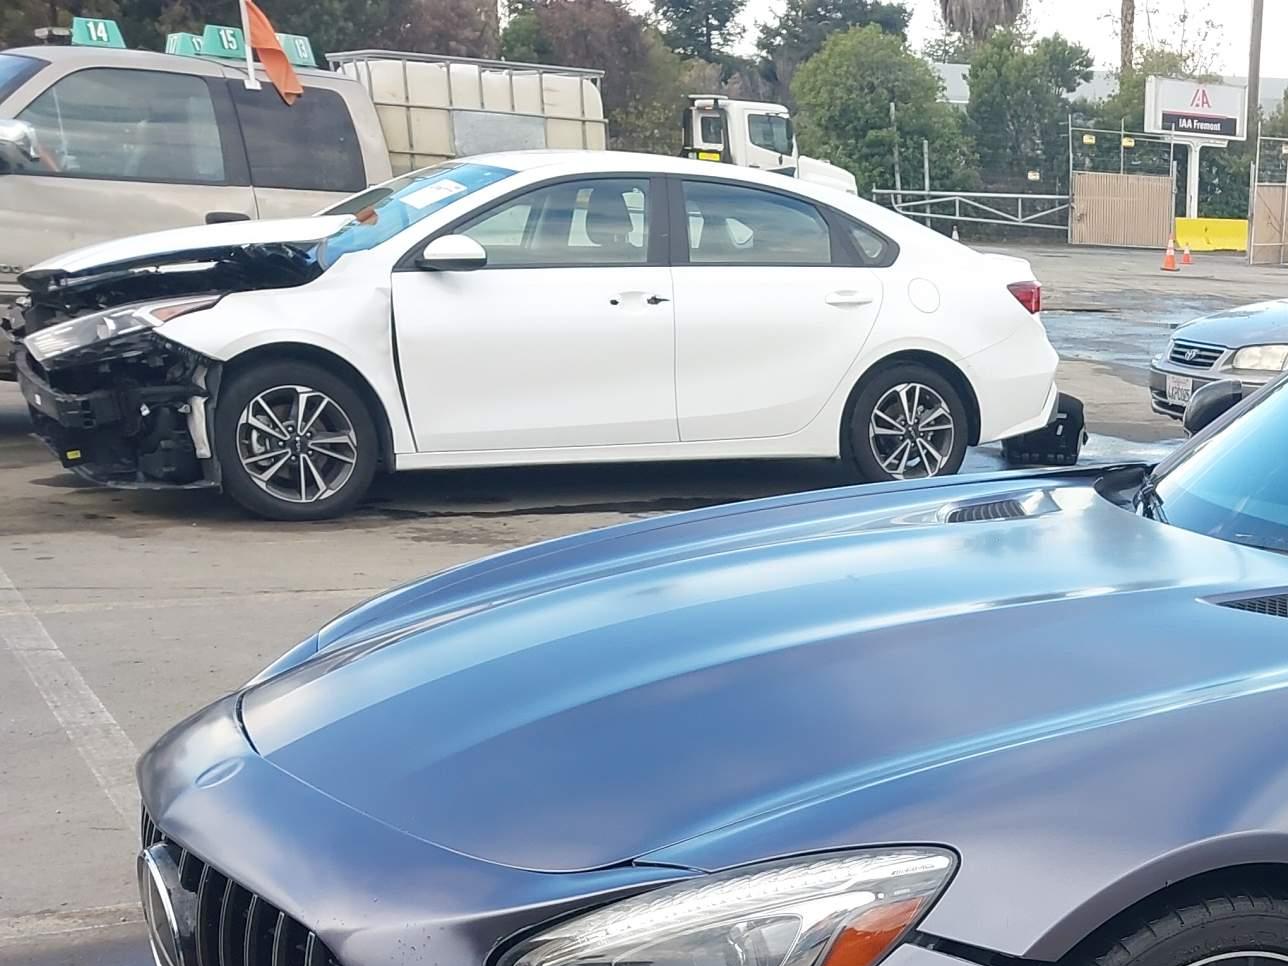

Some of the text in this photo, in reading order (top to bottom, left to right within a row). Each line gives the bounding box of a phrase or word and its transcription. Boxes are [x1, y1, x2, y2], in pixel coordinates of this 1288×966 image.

[86, 21, 108, 42] 14
[219, 29, 237, 50] 15
[1178, 118, 1221, 131] IAA Fremont
